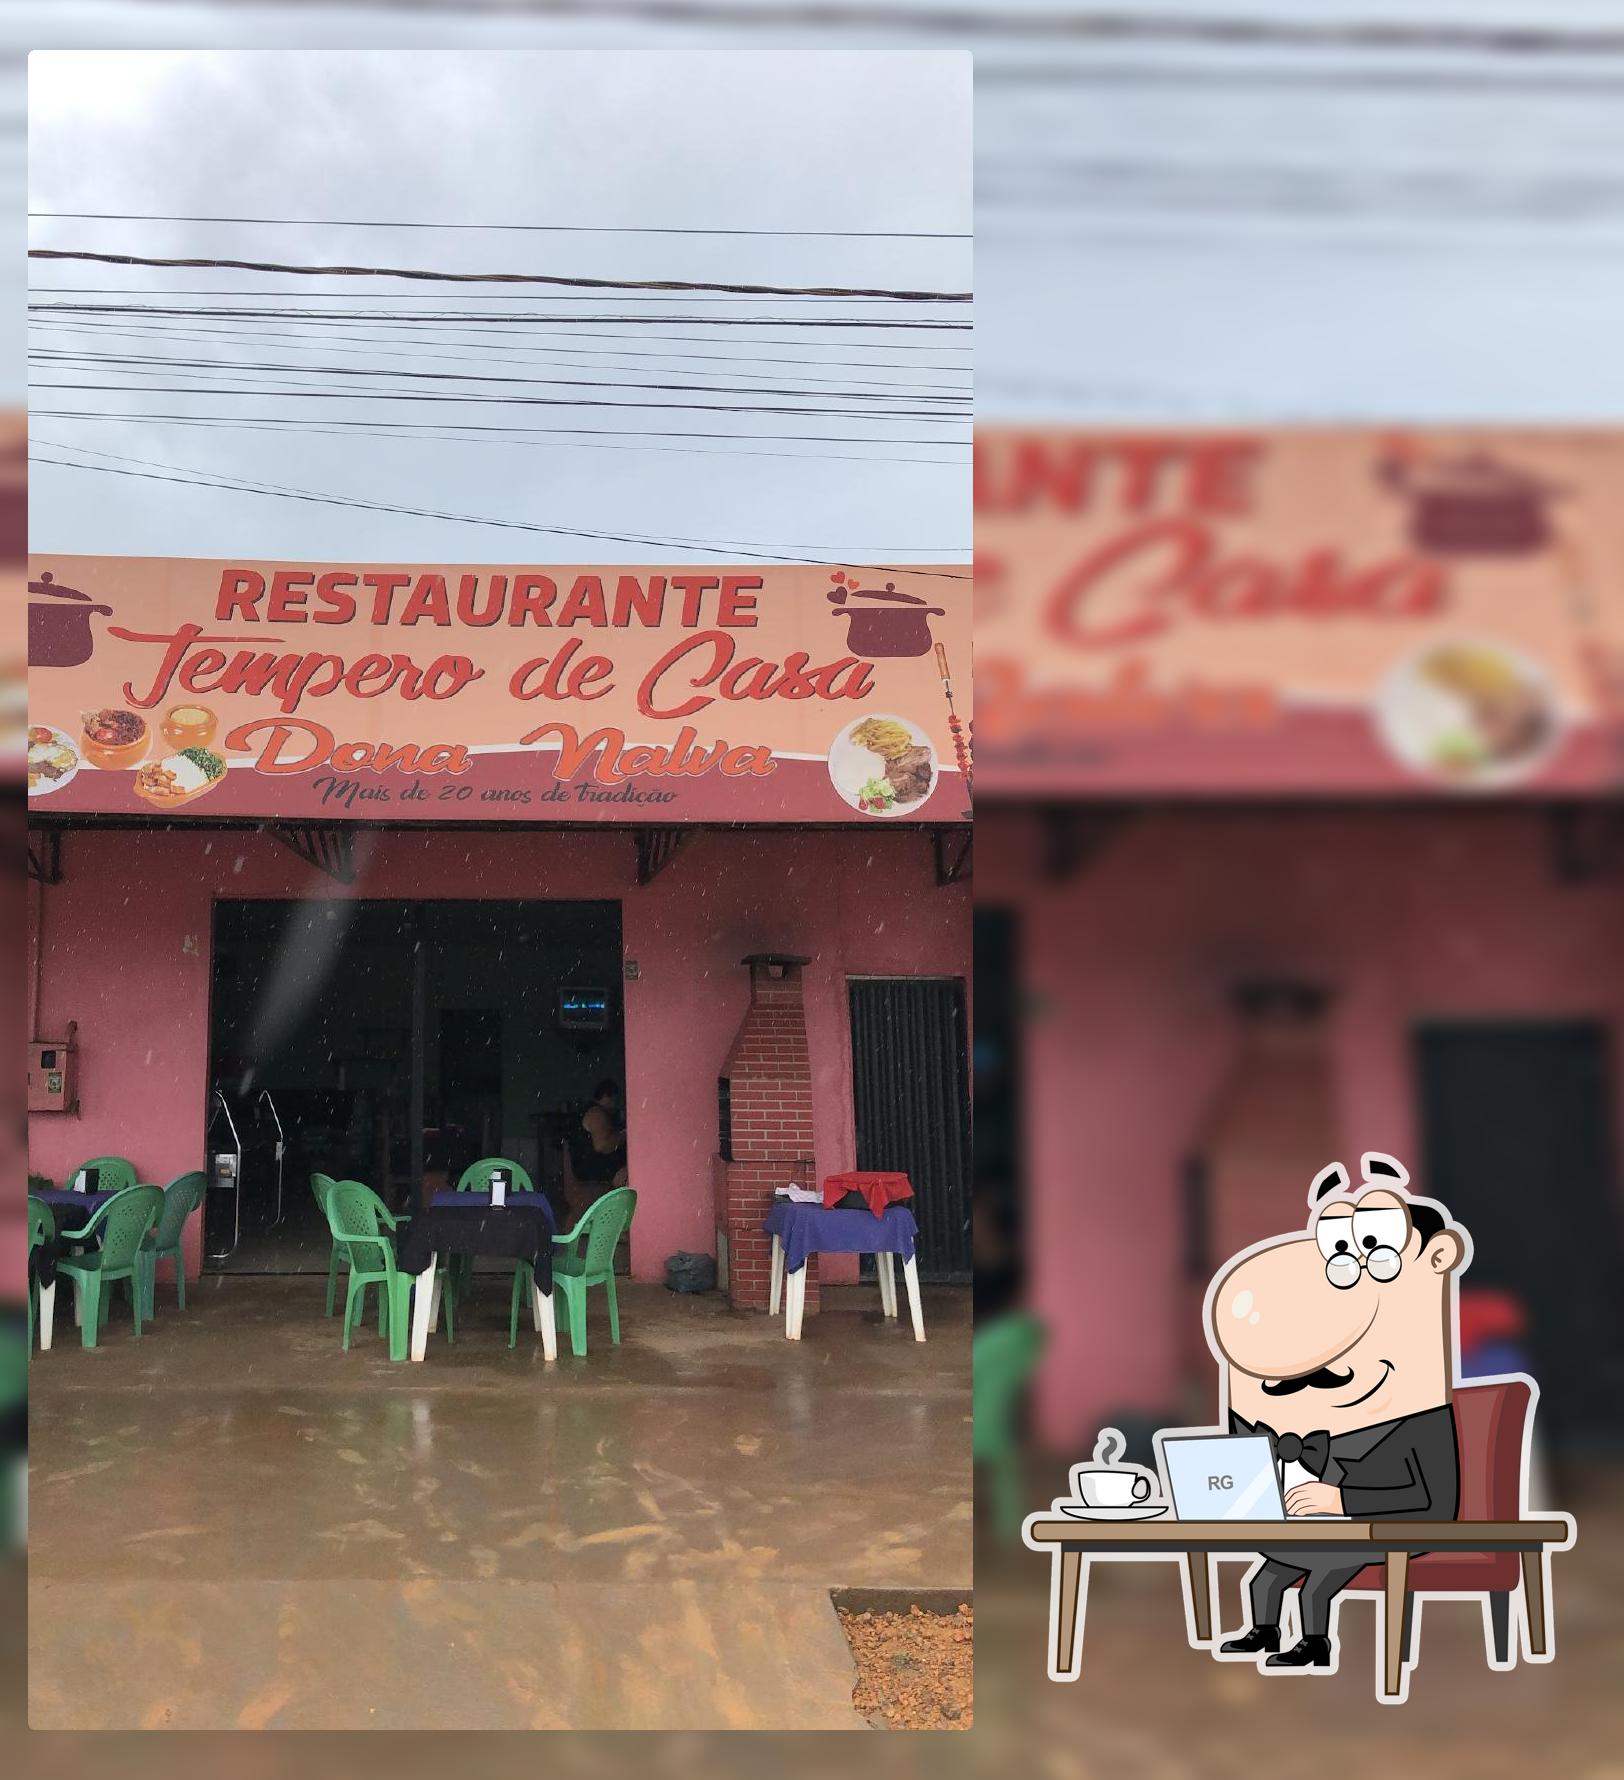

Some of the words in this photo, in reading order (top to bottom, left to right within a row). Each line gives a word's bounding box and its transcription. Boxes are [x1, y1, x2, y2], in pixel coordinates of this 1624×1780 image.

[215, 570, 763, 628] RESTAURANTE
[107, 623, 485, 713] Tempero
[509, 637, 616, 700] de
[637, 630, 875, 719] Casa
[225, 717, 472, 776] Dona
[519, 722, 777, 784] Nalva
[312, 776, 391, 809] Mais
[400, 780, 430, 801] de
[438, 785, 474, 800] 20
[480, 787, 532, 803] anos
[541, 782, 571, 802] de
